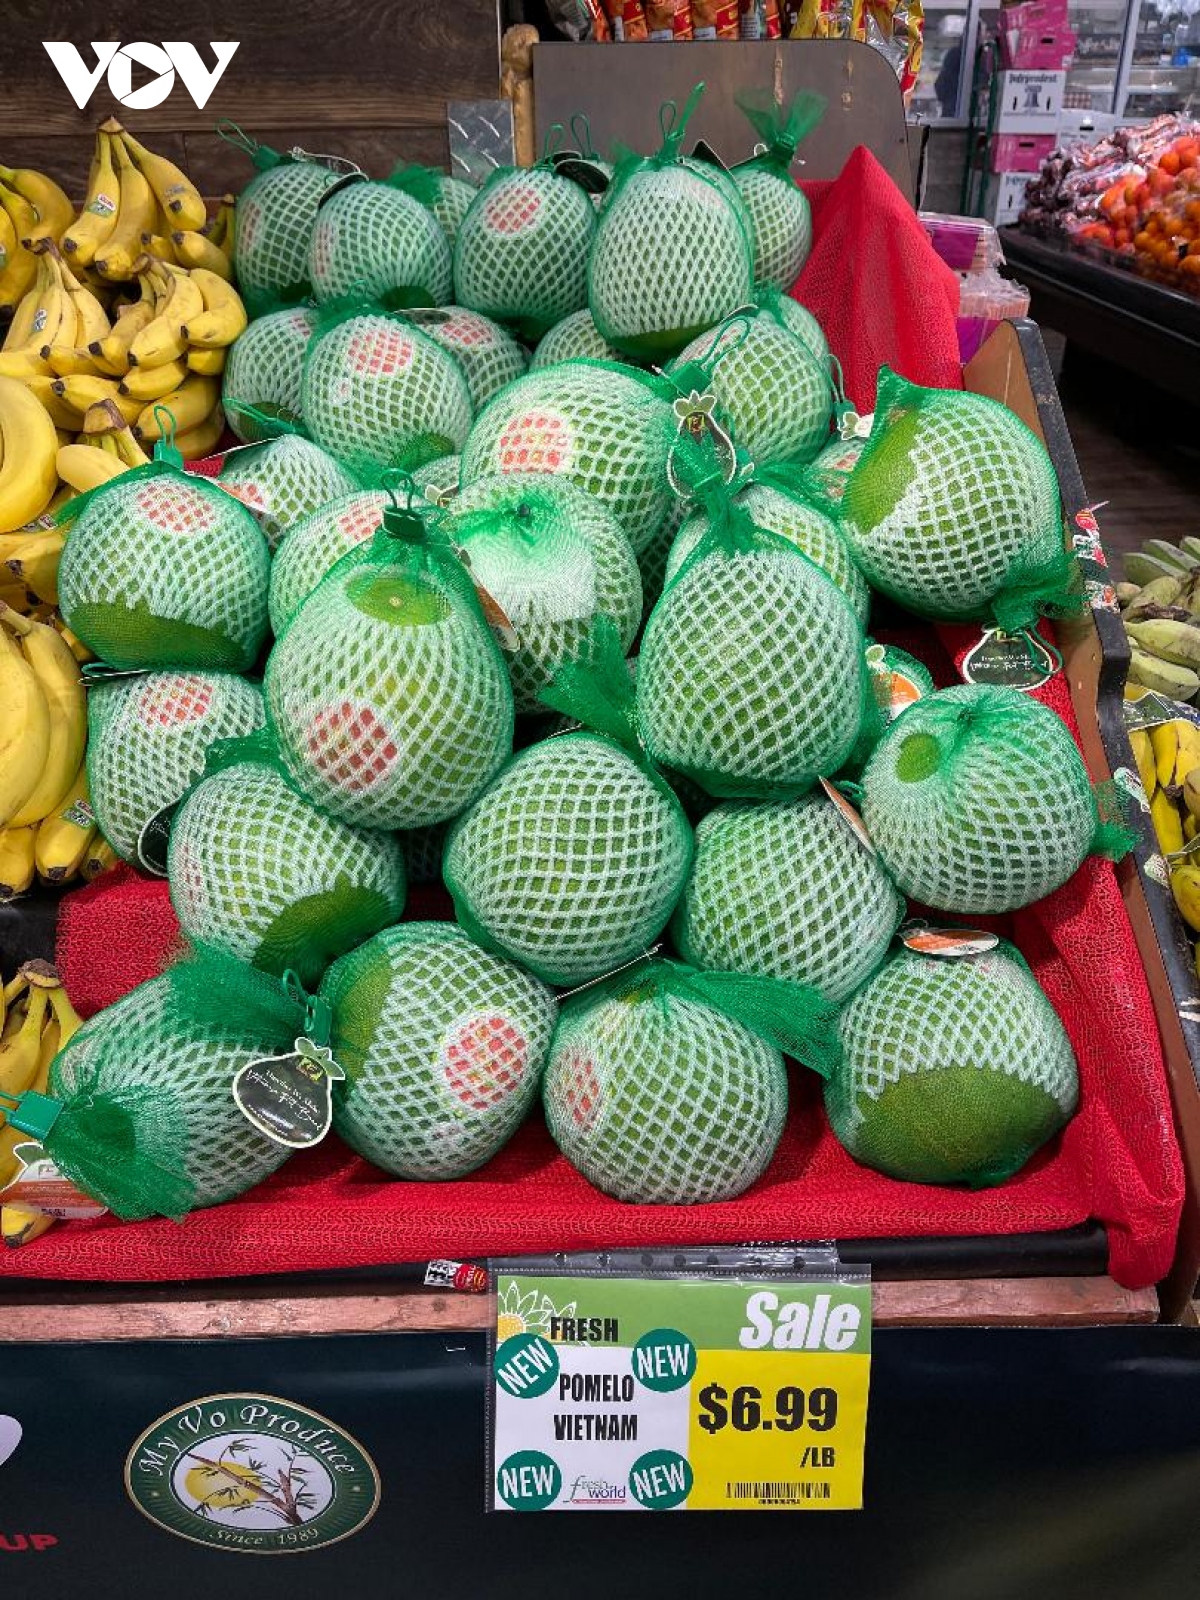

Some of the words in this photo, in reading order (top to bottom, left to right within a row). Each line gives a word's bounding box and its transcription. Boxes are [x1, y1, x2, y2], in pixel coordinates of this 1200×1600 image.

[550, 1316, 619, 1342] FRESH
[738, 1291, 861, 1351] Sale
[497, 1338, 553, 1395] NEW
[636, 1342, 690, 1380] NEW
[559, 1374, 634, 1402] POMELO
[698, 1382, 838, 1435] $6.99
[137, 1438, 182, 1477] My
[178, 1405, 227, 1435] Vo
[239, 1403, 357, 1474] Produce
[553, 1413, 638, 1441] VIETNAM
[799, 1446, 836, 1468] /LB
[501, 1464, 555, 1500] NEW
[589, 1485, 626, 1499] world
[633, 1460, 686, 1501] NEW
[209, 1529, 264, 1546] Since
[277, 1527, 320, 1545] 1989
